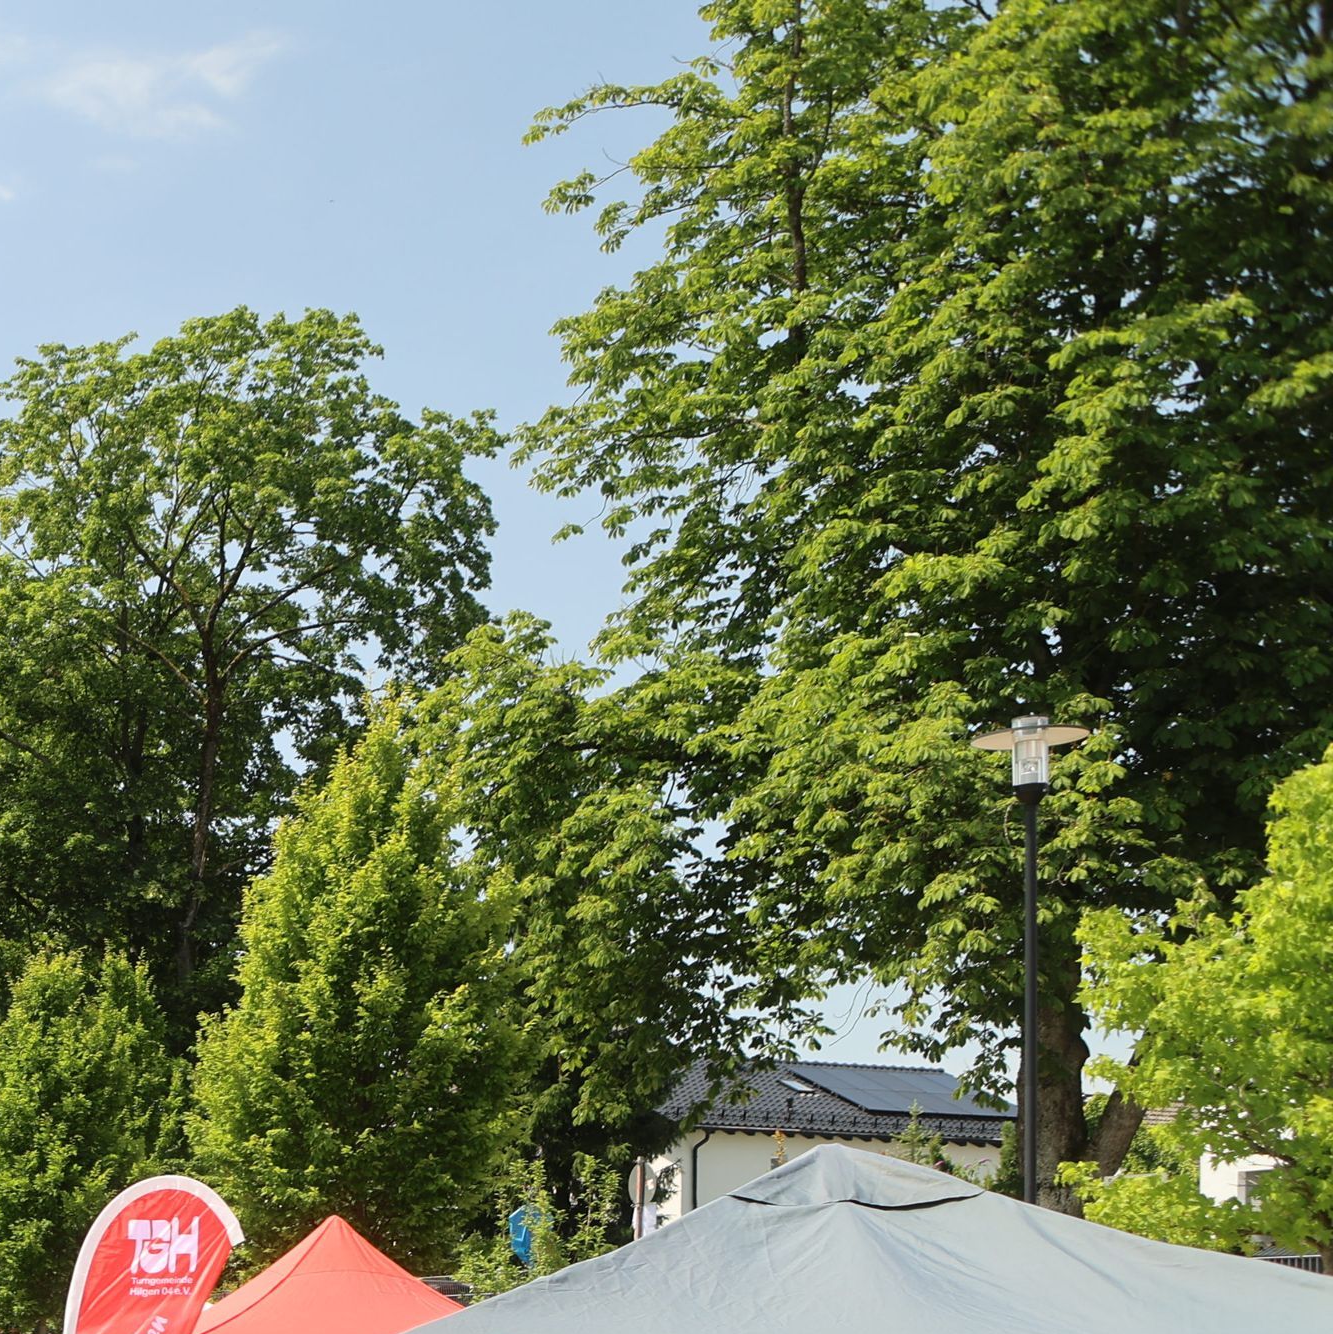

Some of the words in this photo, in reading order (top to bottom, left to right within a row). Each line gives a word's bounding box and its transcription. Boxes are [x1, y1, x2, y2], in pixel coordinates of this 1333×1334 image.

[127, 1215, 200, 1275] TGH
[131, 1276, 194, 1287] Turngemeinde
[129, 1287, 163, 1298] Hilgen
